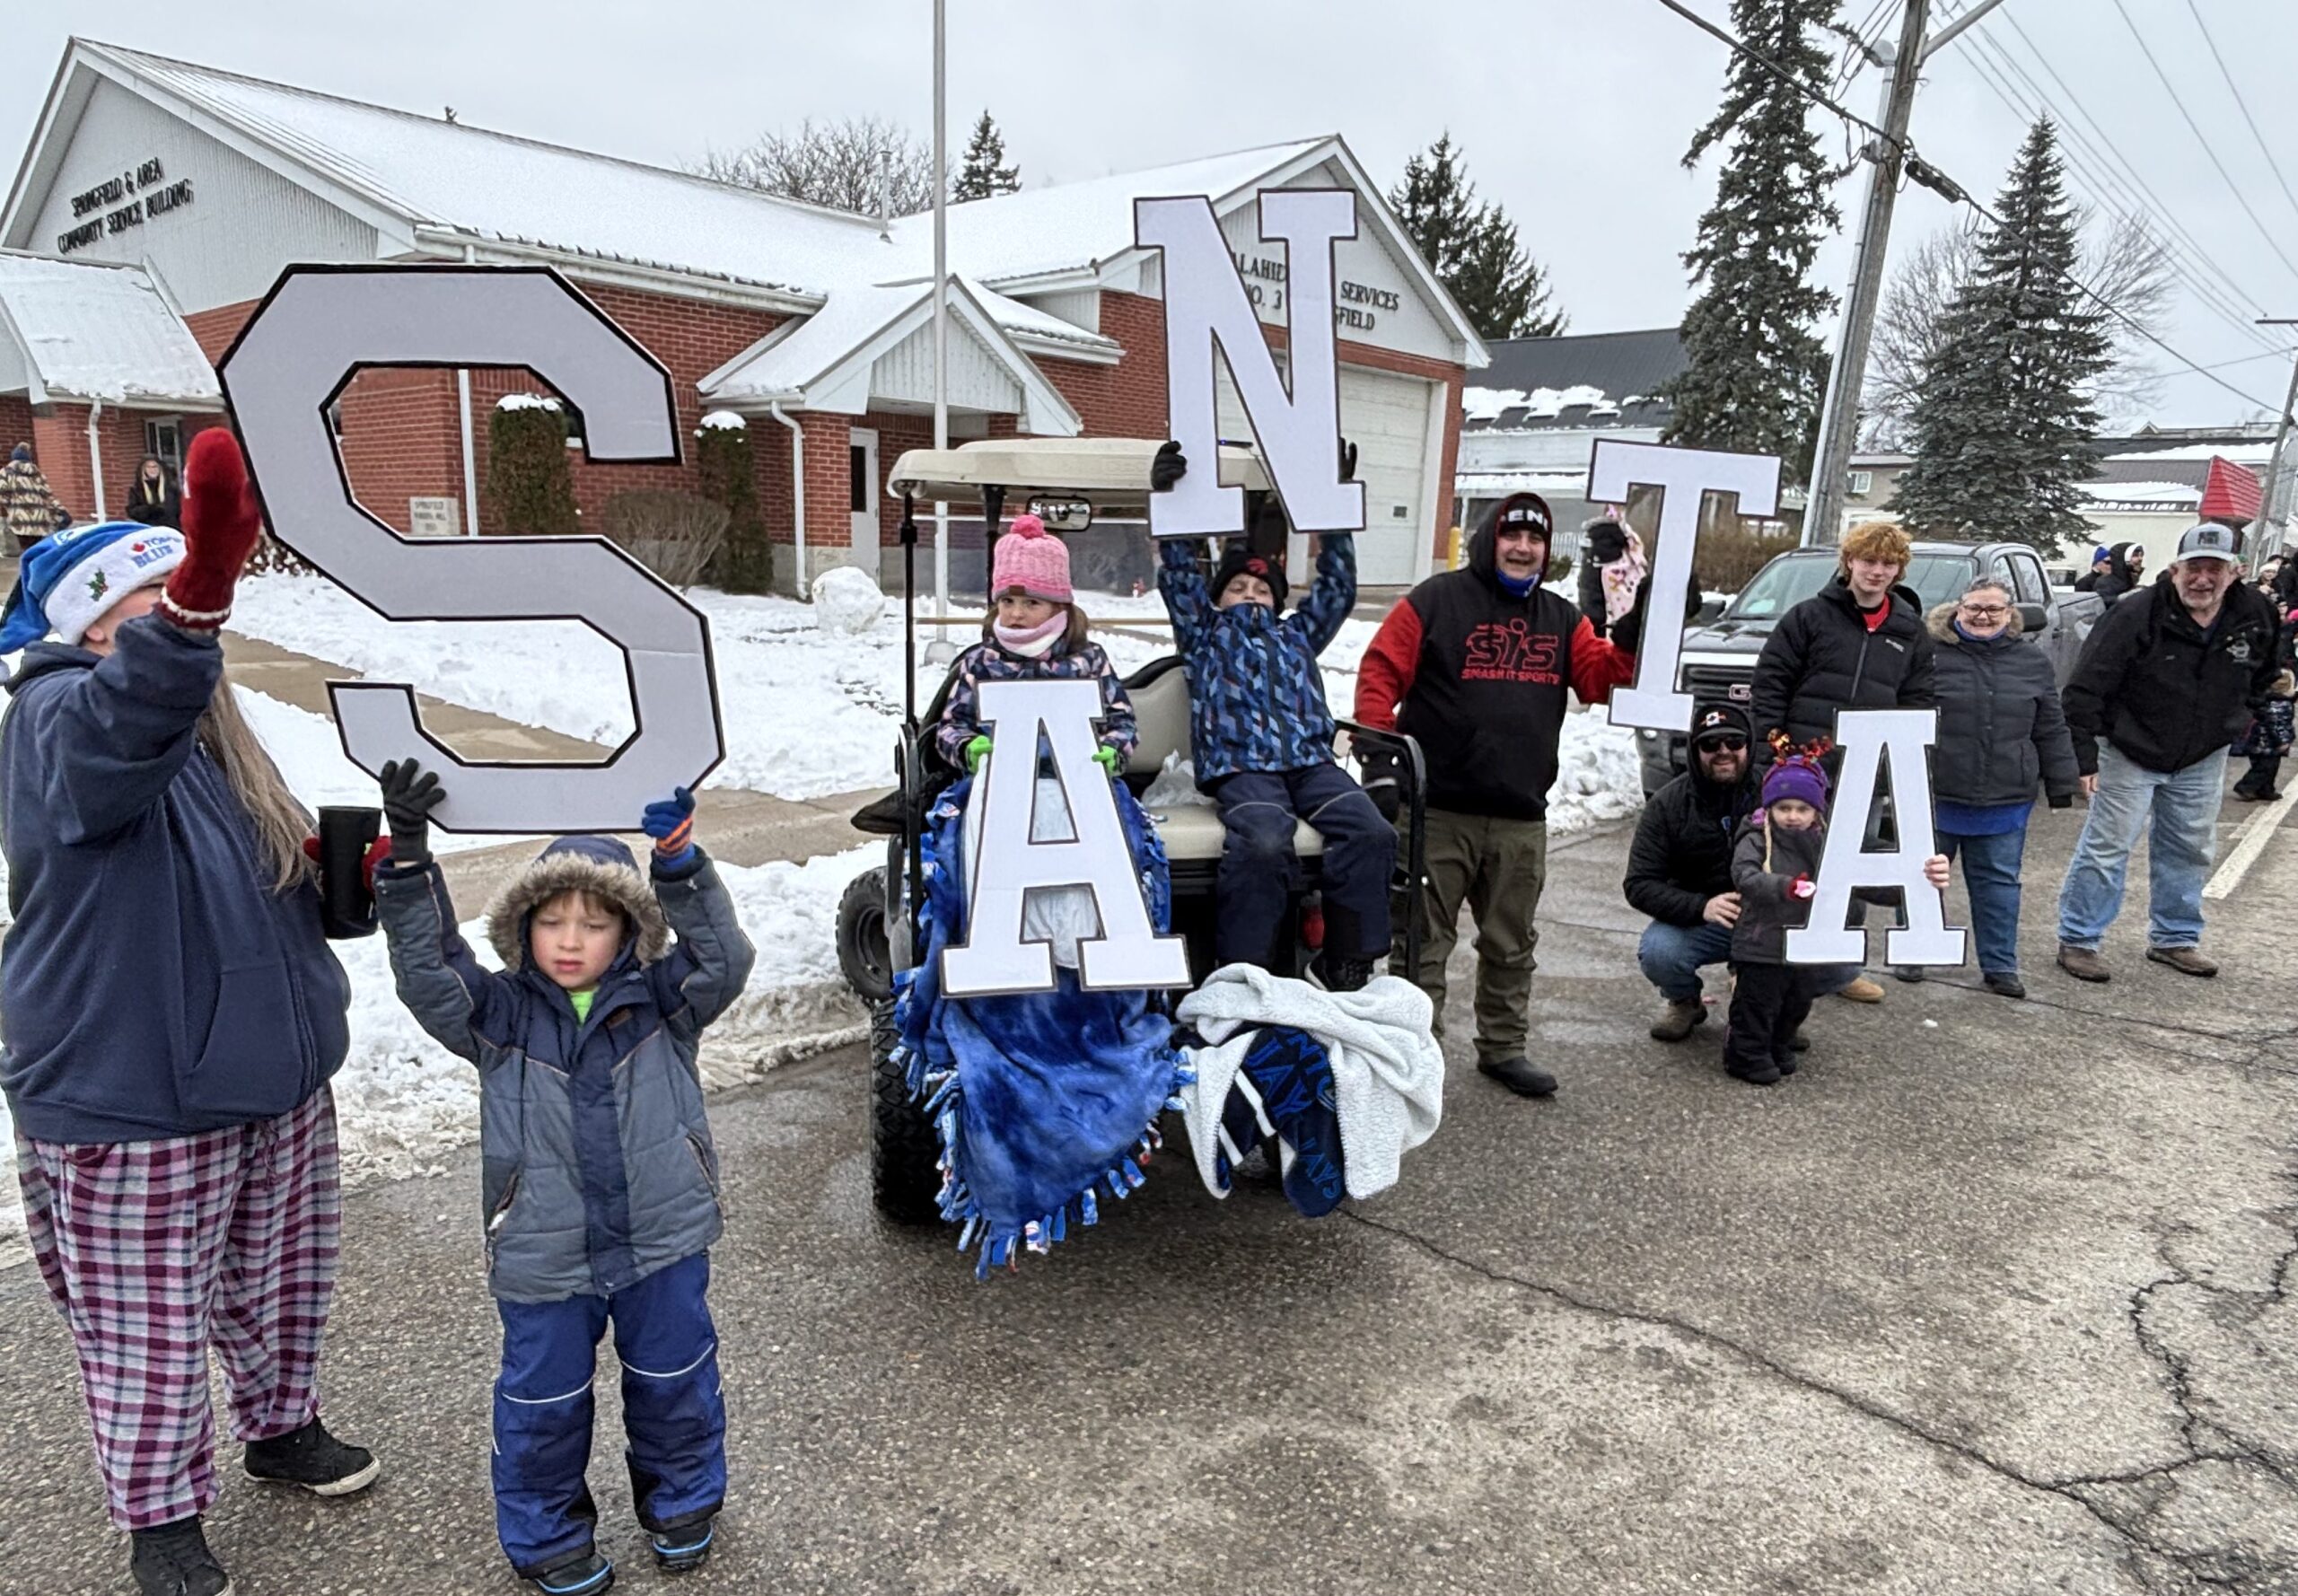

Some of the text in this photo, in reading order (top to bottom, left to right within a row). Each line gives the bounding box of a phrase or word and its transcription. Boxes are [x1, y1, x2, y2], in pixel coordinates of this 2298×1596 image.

[124, 171, 135, 196] &
[136, 156, 163, 189] AREA
[106, 200, 145, 235] SERVICE
[145, 178, 195, 219] BUILDING
[1232, 251, 1400, 311] LAHID SERVICES
[1274, 287, 1283, 310] 3
[1461, 668, 1560, 685] SMASH IT SPORTS
